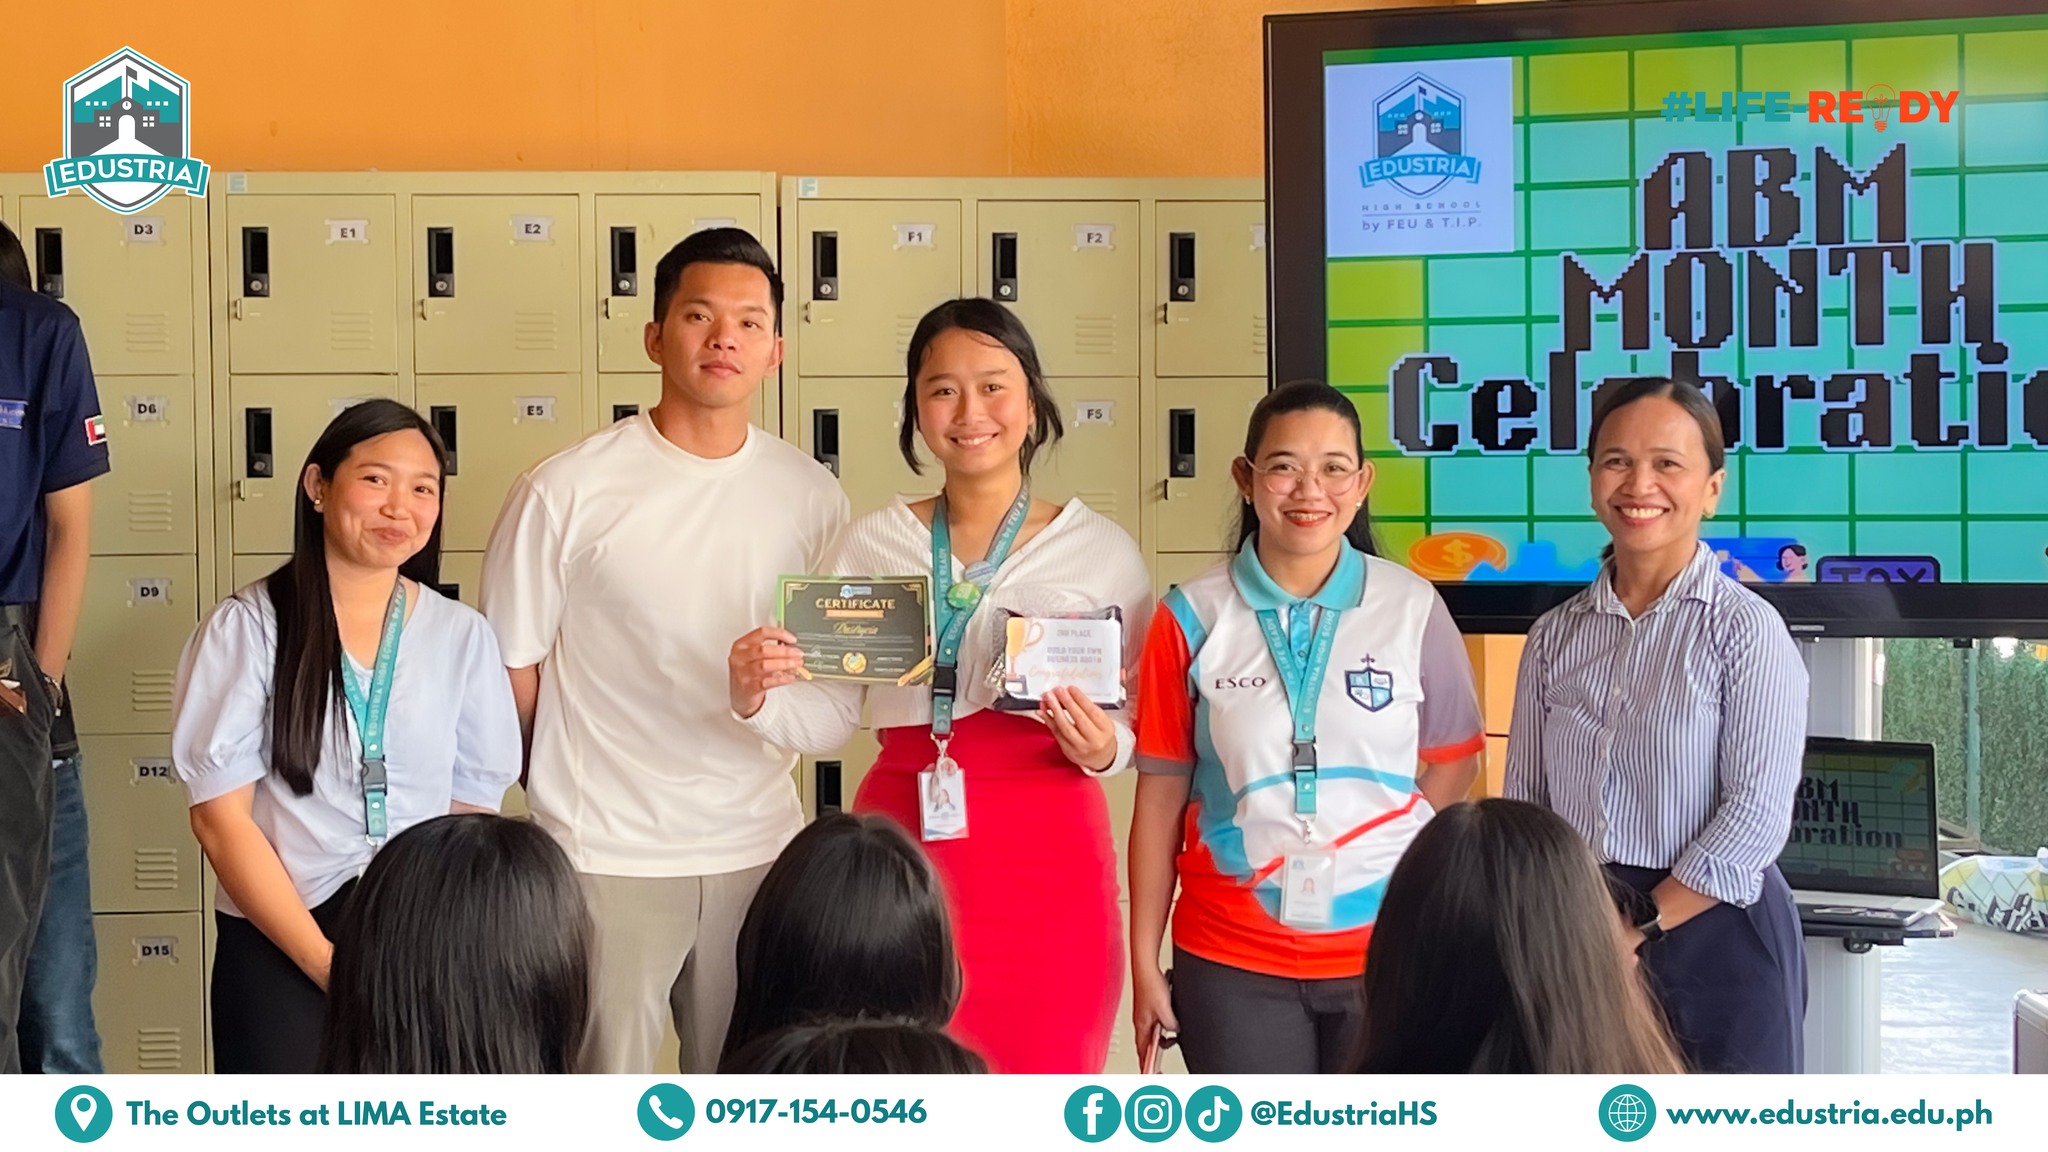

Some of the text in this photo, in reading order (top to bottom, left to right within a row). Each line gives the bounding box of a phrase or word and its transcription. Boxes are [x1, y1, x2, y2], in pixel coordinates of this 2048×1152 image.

[1369, 157, 1471, 179] EDUSTRIA
[229, 174, 245, 192] E
[1643, 143, 1906, 249] ABM
[1362, 201, 1481, 212] HIGH SCHOOL
[134, 224, 153, 235] D3
[525, 223, 541, 235] E2
[1362, 220, 1380, 232] by
[1387, 219, 1417, 230] FEU
[1425, 218, 1434, 229] &
[340, 227, 356, 238] E1
[908, 231, 922, 243] F1
[1087, 233, 1103, 244] F2
[1563, 243, 1994, 350] MONTH
[1393, 342, 2048, 451] Celbrati
[138, 403, 156, 415] D6
[527, 405, 544, 417] E5
[140, 586, 159, 598] D9
[815, 598, 896, 609] CERTIFICATE
[1265, 617, 1282, 648] READY
[368, 688, 382, 737] EDUSTRIA
[376, 662, 388, 685] HIGH
[382, 621, 397, 660] SCHOOL
[1304, 665, 1320, 713] EDUSTRIA
[1315, 640, 1327, 664] HIGH
[1215, 677, 1266, 690] ESCO
[139, 766, 167, 777] D12
[142, 945, 170, 956] D15
